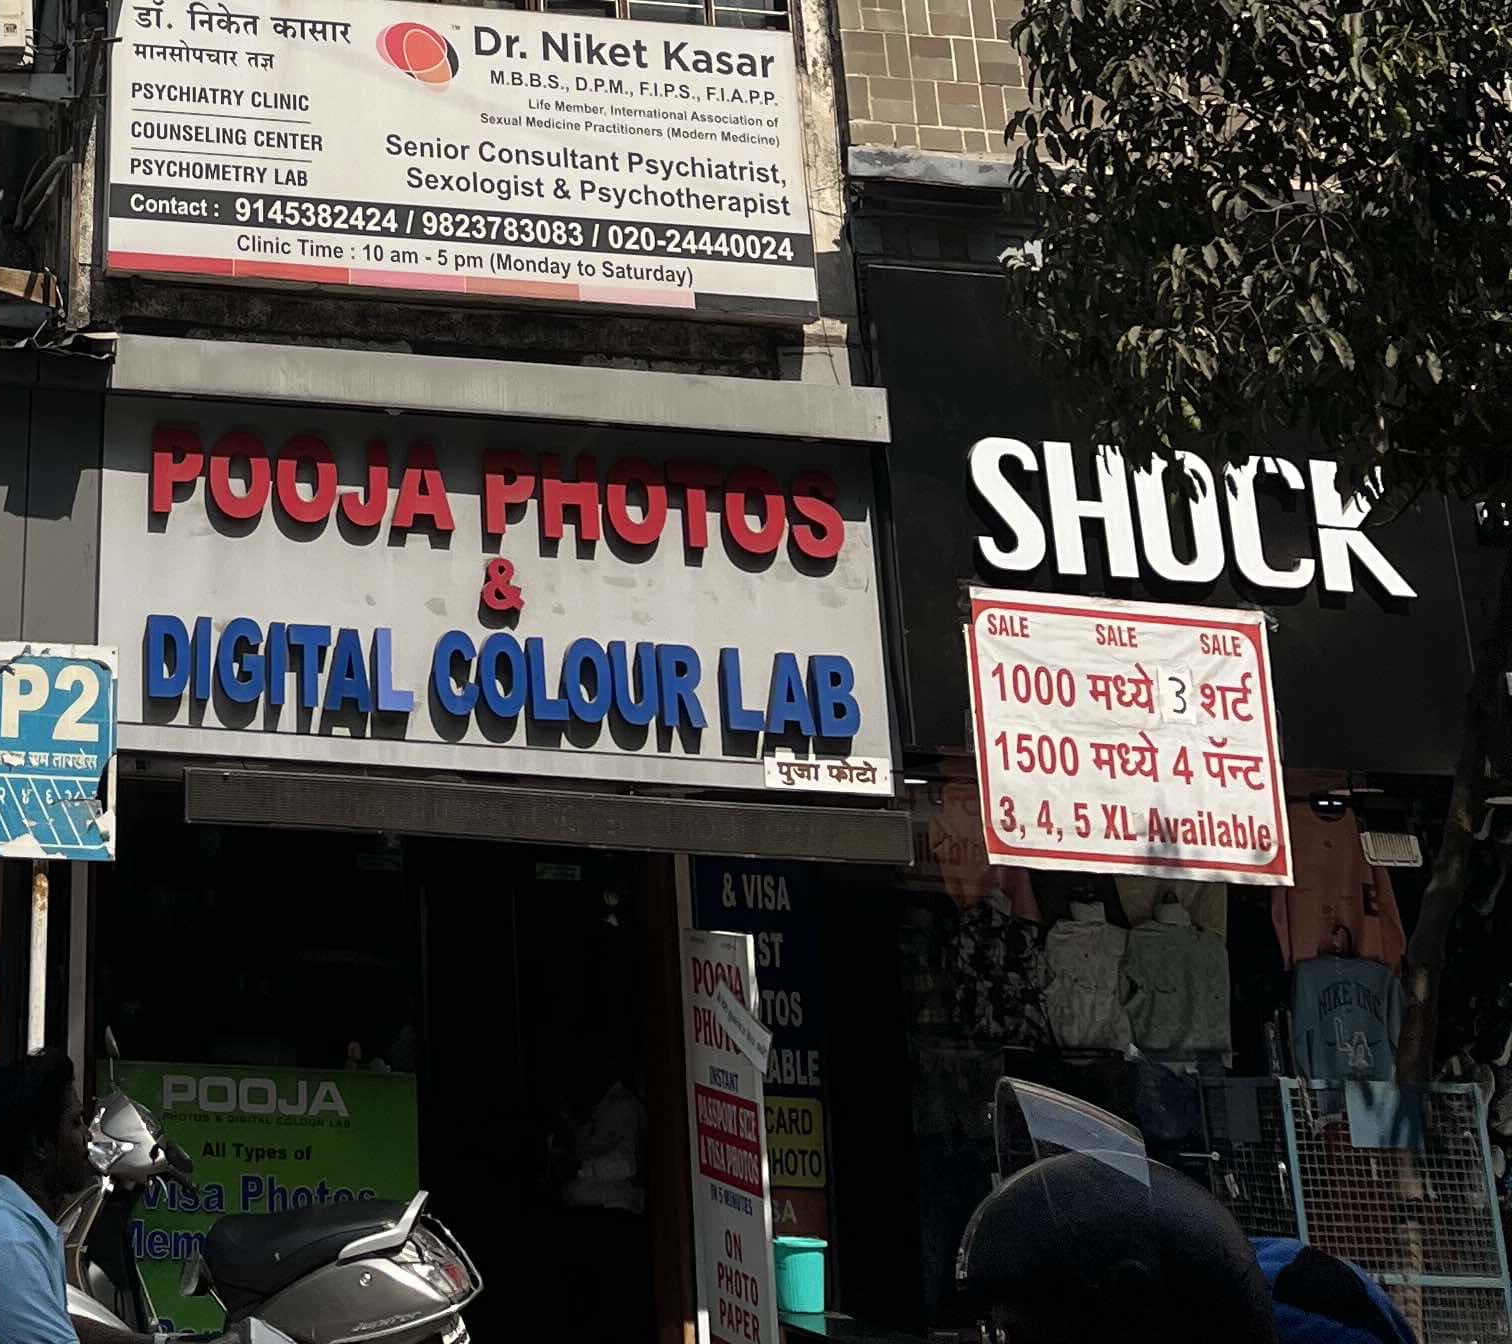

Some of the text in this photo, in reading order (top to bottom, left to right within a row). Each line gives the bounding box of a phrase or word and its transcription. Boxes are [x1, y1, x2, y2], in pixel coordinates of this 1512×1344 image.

[133, 2, 351, 44] डॉ. निकेत कासार
[133, 40, 274, 71] मानसोपचार तज्ञ
[474, 26, 774, 78] Dr. Niket Kasar
[132, 83, 308, 111] PSYCHIATRY CLINIC
[491, 70, 778, 106] M.B.B.S., D.P.M., F.I.P.S., F.I.A.P.P.
[481, 113, 779, 148] Sexual Medicine Practitioners (Modern Medicine)
[529, 99, 778, 127] Life Member, International Association of
[132, 121, 322, 151] COUNSELING CENTER
[131, 158, 307, 186] PSYCHOMETRY LAB
[386, 134, 786, 188] Senior Consultant Psychiatrist,
[407, 167, 790, 218] Sexologist & Psychotherapist
[131, 194, 793, 260] Contact 9145382424 9823783083 020-24440024
[237, 235, 692, 288] Clinic Time 10 am 5 pm (Monday to Saturday)
[152, 427, 845, 559] POOJA PHOTOS
[969, 436, 1417, 597] SHOCK
[482, 558, 524, 612] &
[988, 614, 1241, 657] SALE SALE SALE
[144, 613, 861, 739] DIGITAL COLOUR LAB
[992, 663, 1253, 721] 1000 मध्ये 3 शर्ट
[0, 663, 99, 742] P2
[995, 731, 1078, 776] 1500
[1090, 731, 1159, 782] मध्ये
[1173, 746, 1193, 784] 4
[1000, 796, 1272, 852] 3, 4, 5 XL Available
[741, 874, 790, 911] VISA
[161, 1075, 350, 1117] POOJA
[202, 1142, 312, 1163] All Types of
[724, 1230, 742, 1263] ON
[718, 1262, 759, 1306] PHOTO
[719, 1303, 760, 1344] PAPER
